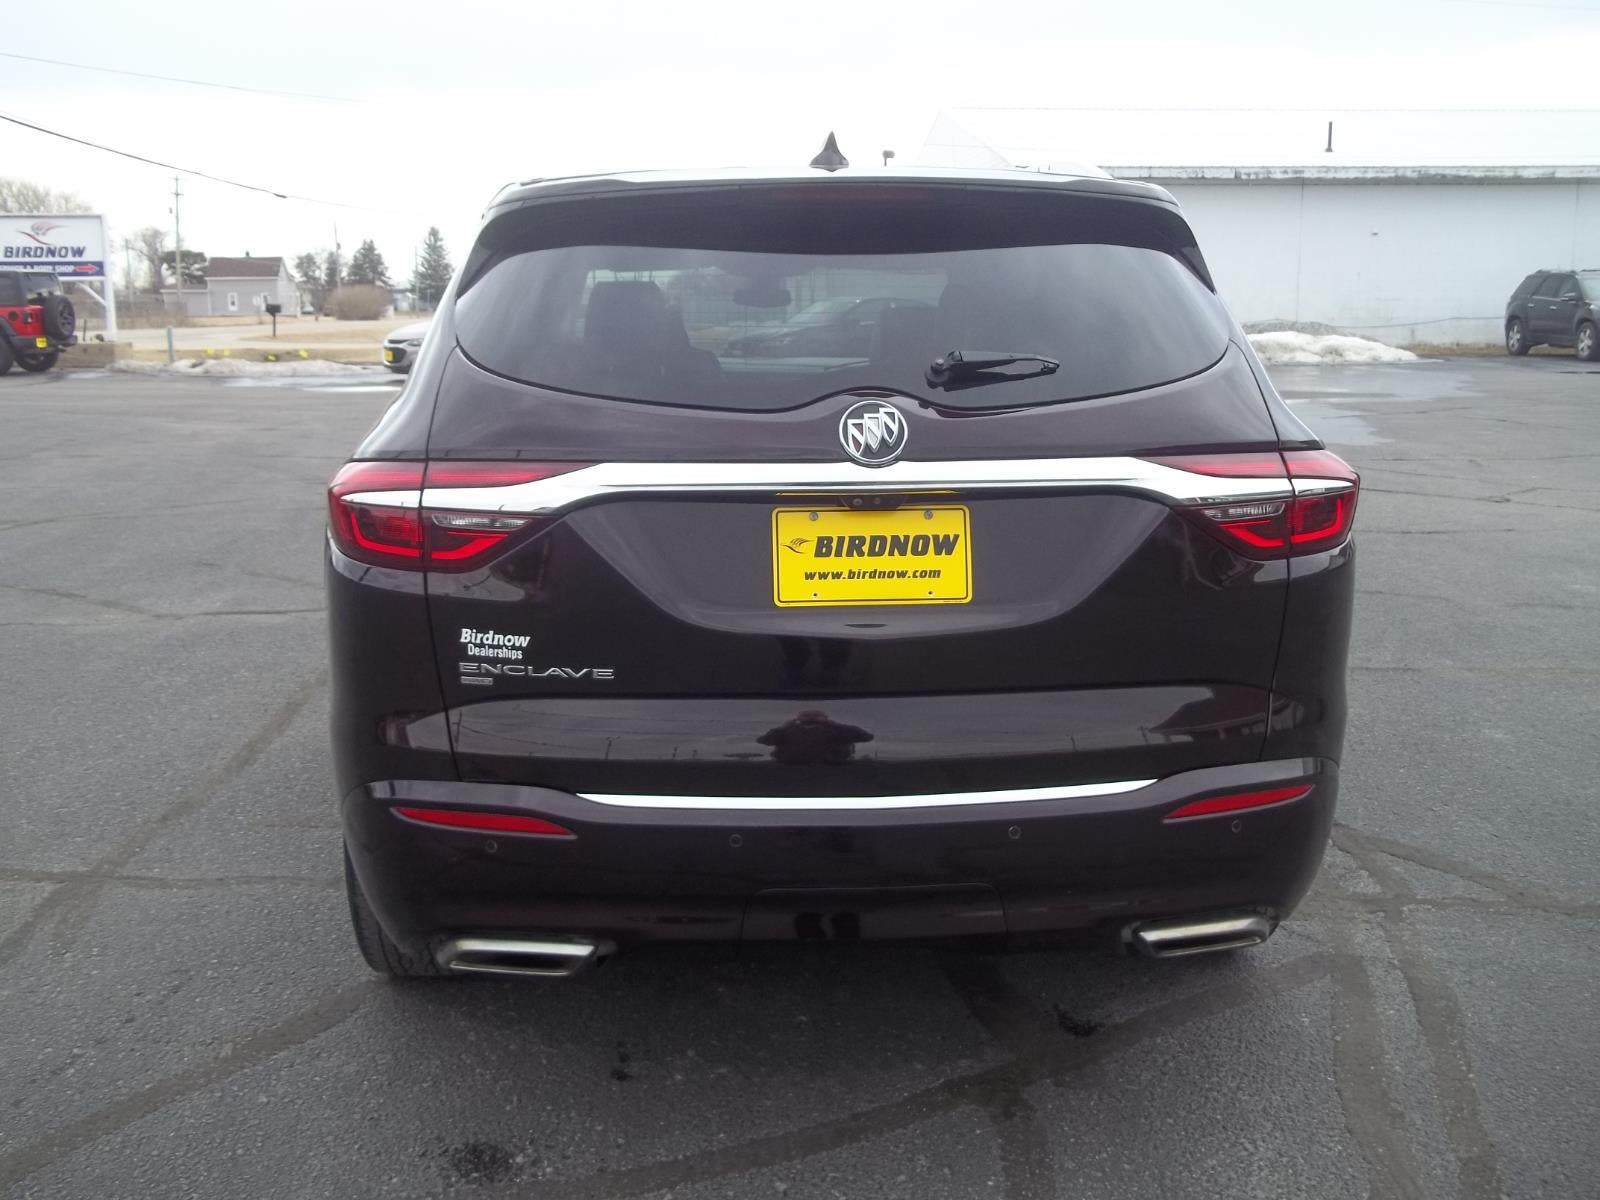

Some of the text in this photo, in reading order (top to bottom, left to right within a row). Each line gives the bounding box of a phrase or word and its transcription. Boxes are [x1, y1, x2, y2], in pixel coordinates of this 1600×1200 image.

[3, 246, 86, 258] BIRDNOW
[813, 534, 960, 558] BIRDNOW
[804, 569, 941, 581] www.birdnow.com
[460, 628, 531, 647] Birdnow
[467, 643, 523, 660] Dealerships
[459, 662, 615, 679] ENCLAVE
